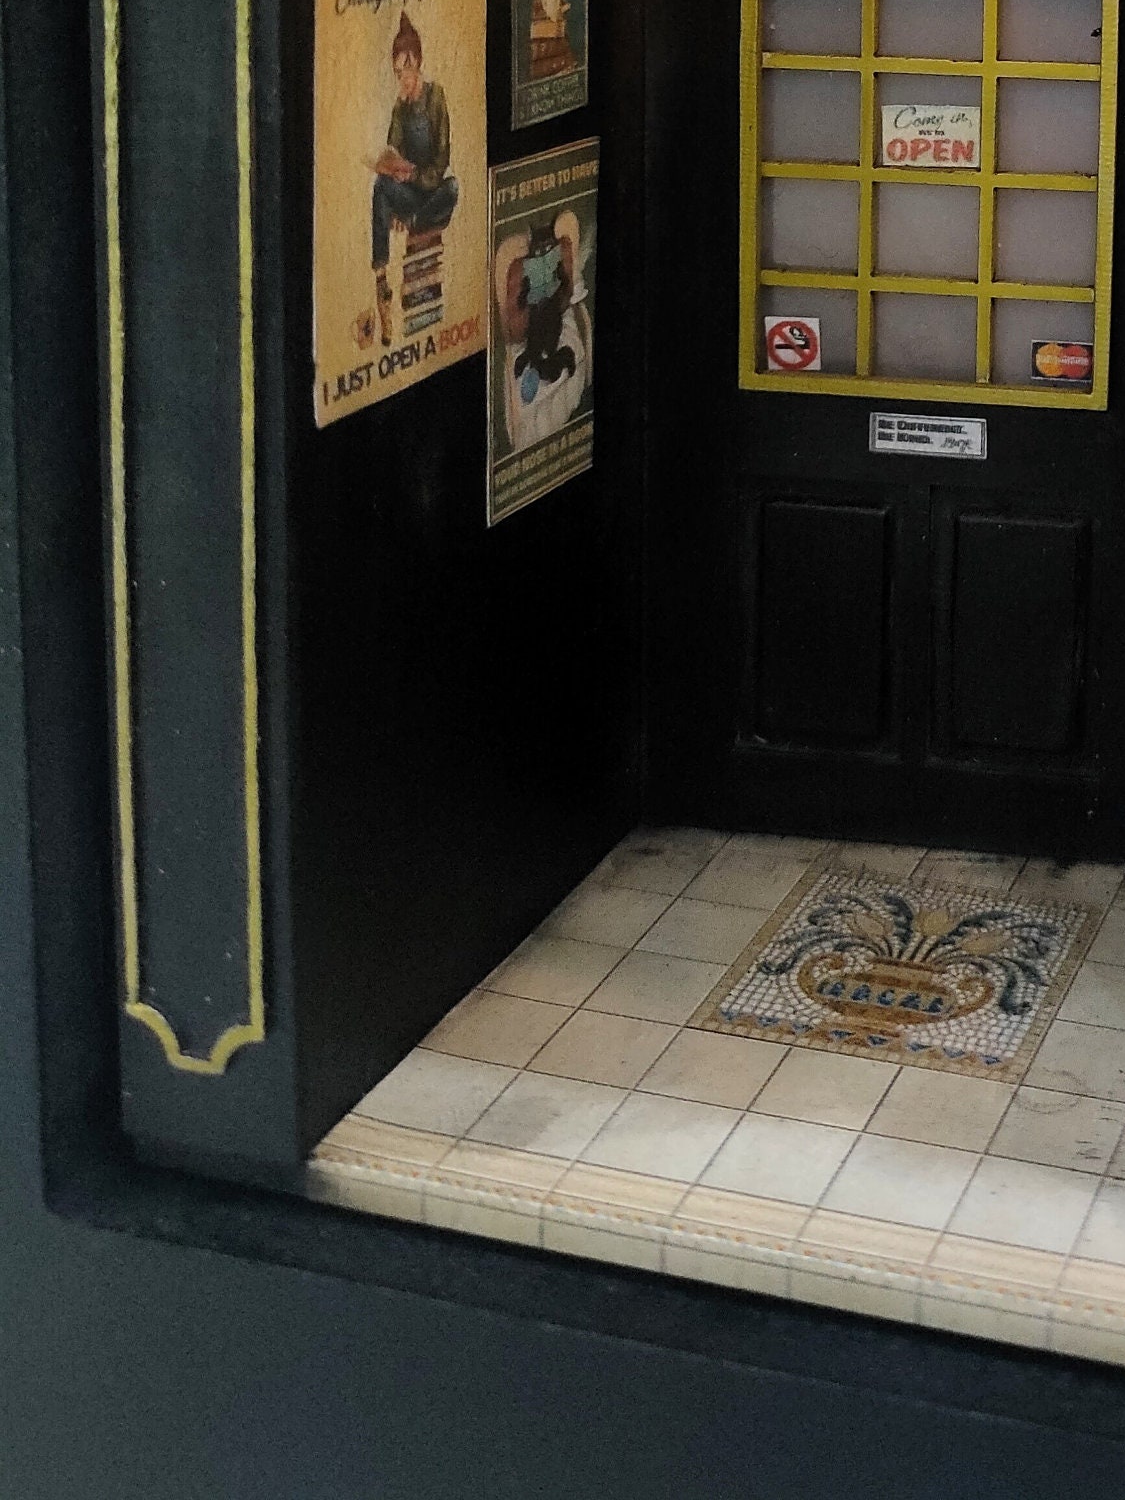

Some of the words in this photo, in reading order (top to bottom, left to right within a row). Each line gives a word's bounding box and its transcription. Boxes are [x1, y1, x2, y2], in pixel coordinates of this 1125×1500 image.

[886, 138, 975, 162] OPEN
[323, 382, 329, 406] I
[333, 361, 374, 401] JUST
[378, 341, 421, 380] OPEN
[424, 335, 437, 360] A
[438, 314, 480, 351] BOOK
